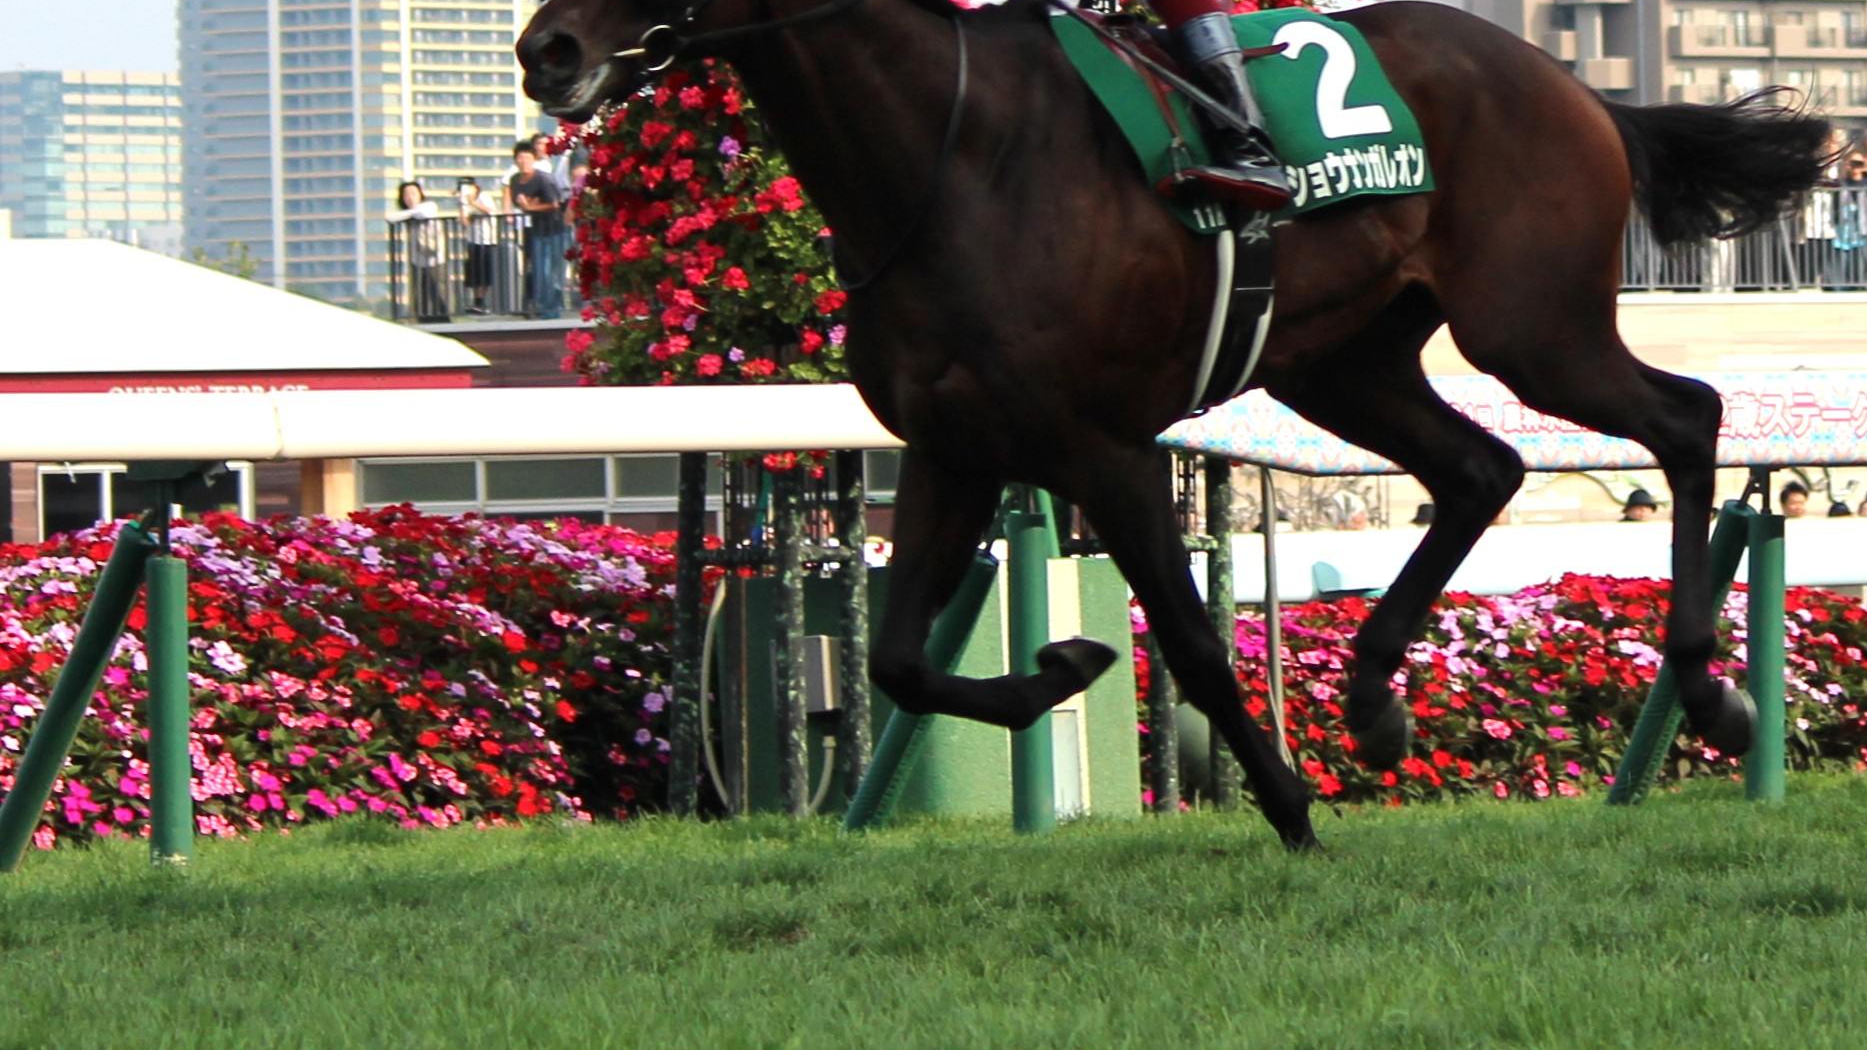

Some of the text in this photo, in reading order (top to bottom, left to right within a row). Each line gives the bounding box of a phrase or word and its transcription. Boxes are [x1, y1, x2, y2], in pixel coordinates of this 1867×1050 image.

[1272, 20, 1393, 139] 2
[1285, 143, 1426, 208] ショウナンガレオン
